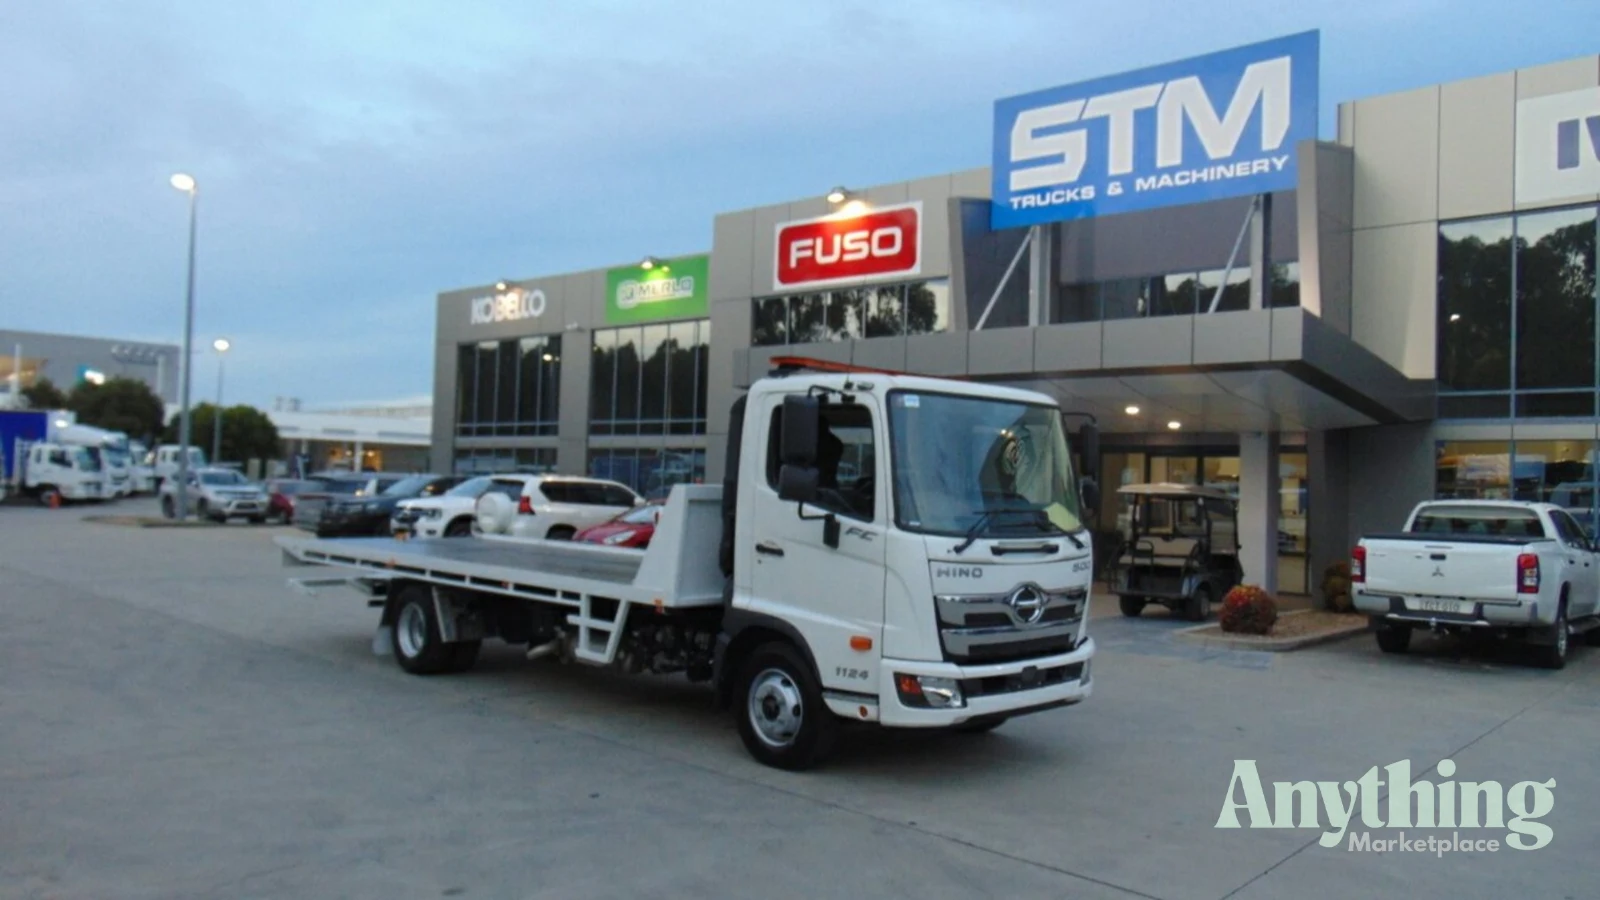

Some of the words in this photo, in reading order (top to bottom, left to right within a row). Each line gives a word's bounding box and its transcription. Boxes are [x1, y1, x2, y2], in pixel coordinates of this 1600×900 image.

[1010, 55, 1292, 192] STM
[1010, 185, 1096, 210] TRUCKS
[1106, 181, 1124, 196] &
[1134, 154, 1290, 192] MACHINERY
[789, 225, 904, 269] FUSO
[470, 288, 546, 325] KOBELCO
[936, 566, 983, 579] HINO
[835, 665, 870, 681] 1124
